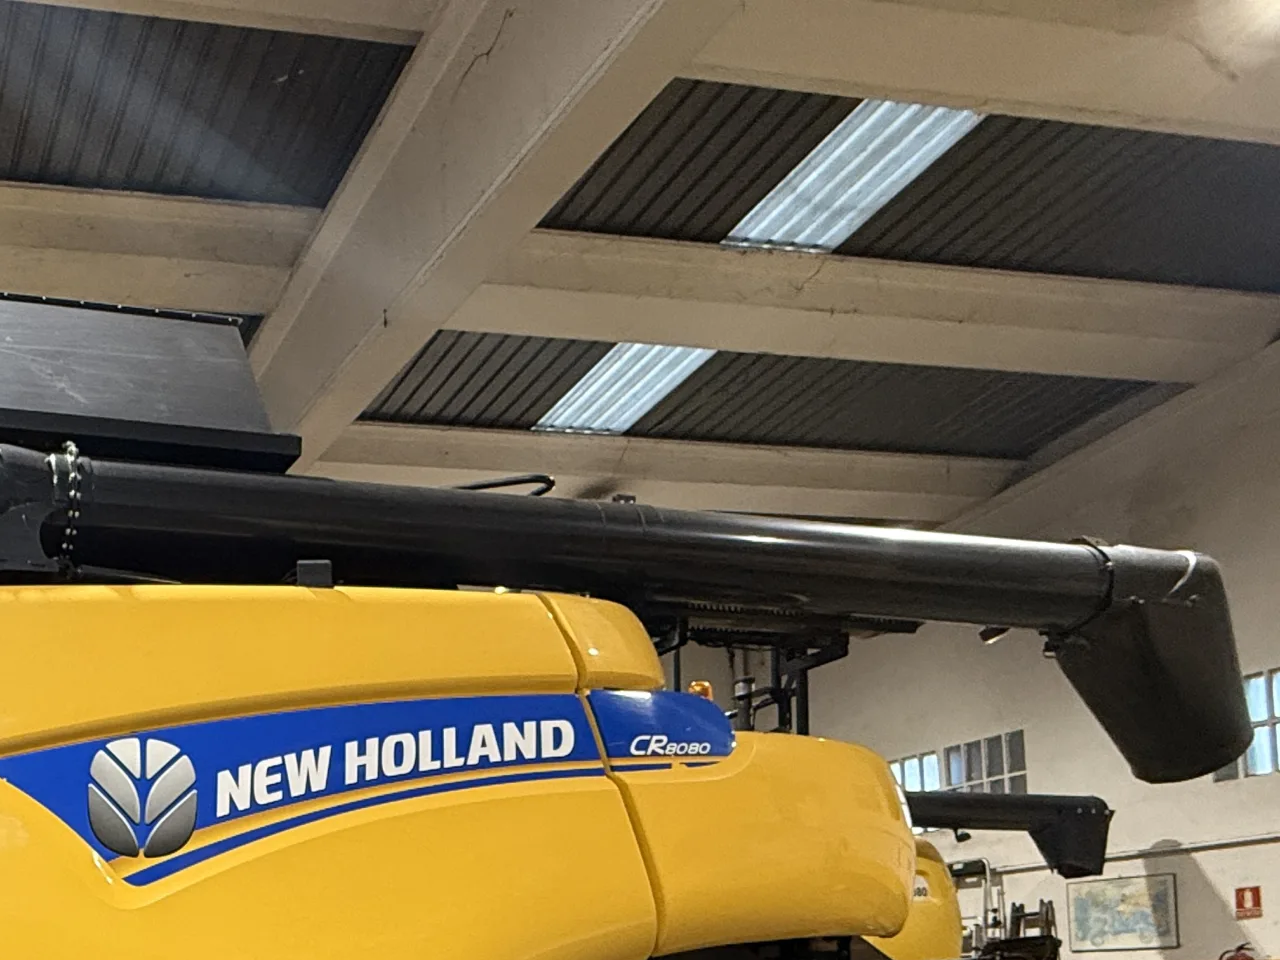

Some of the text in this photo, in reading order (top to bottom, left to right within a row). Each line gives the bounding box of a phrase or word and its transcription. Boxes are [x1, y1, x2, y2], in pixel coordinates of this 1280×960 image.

[216, 719, 575, 818] NEW HOLLAND
[630, 734, 711, 755] CR8080
